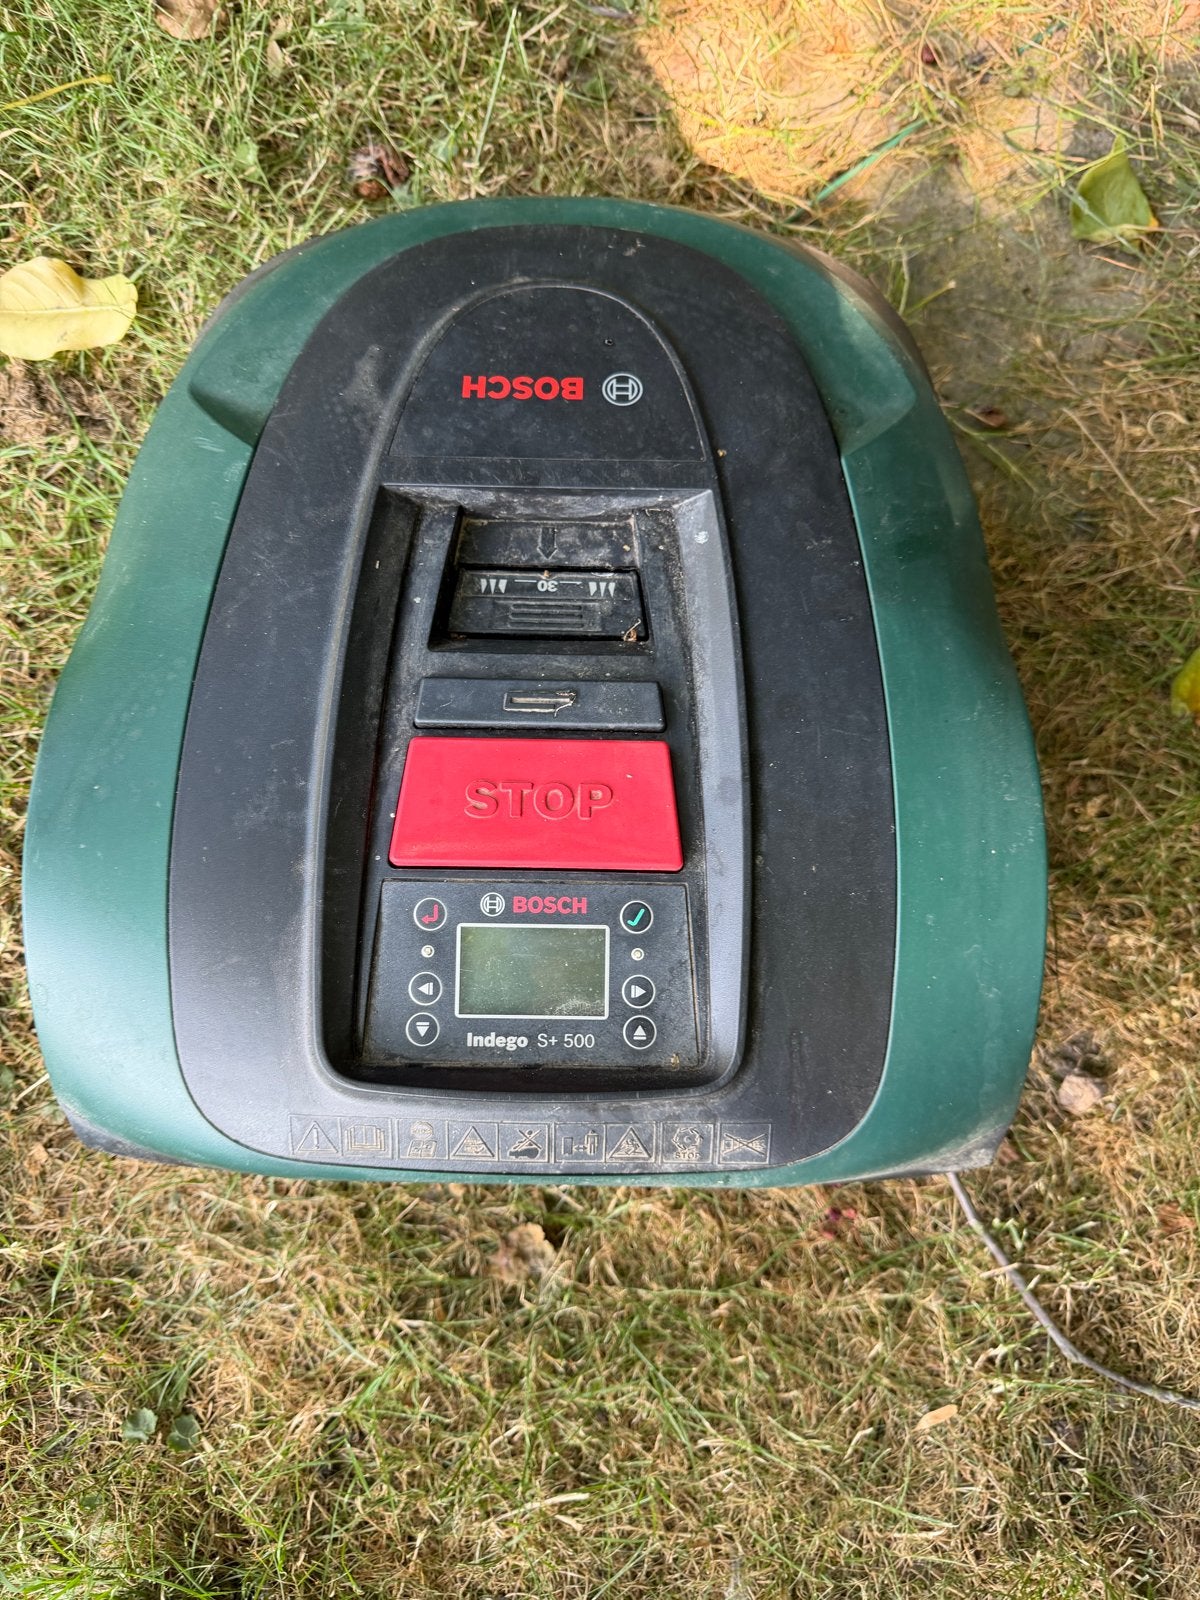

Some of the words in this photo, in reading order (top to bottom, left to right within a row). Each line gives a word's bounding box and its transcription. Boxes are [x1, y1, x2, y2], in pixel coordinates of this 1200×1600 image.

[462, 375, 584, 400] BOSCH
[537, 580, 558, 592] 30
[464, 780, 613, 820] STOP
[512, 896, 588, 914] BOSCH
[466, 1033, 528, 1050] Indego
[537, 1034, 558, 1048] S+
[563, 1034, 596, 1048] 500
[674, 1151, 701, 1159] STOP
